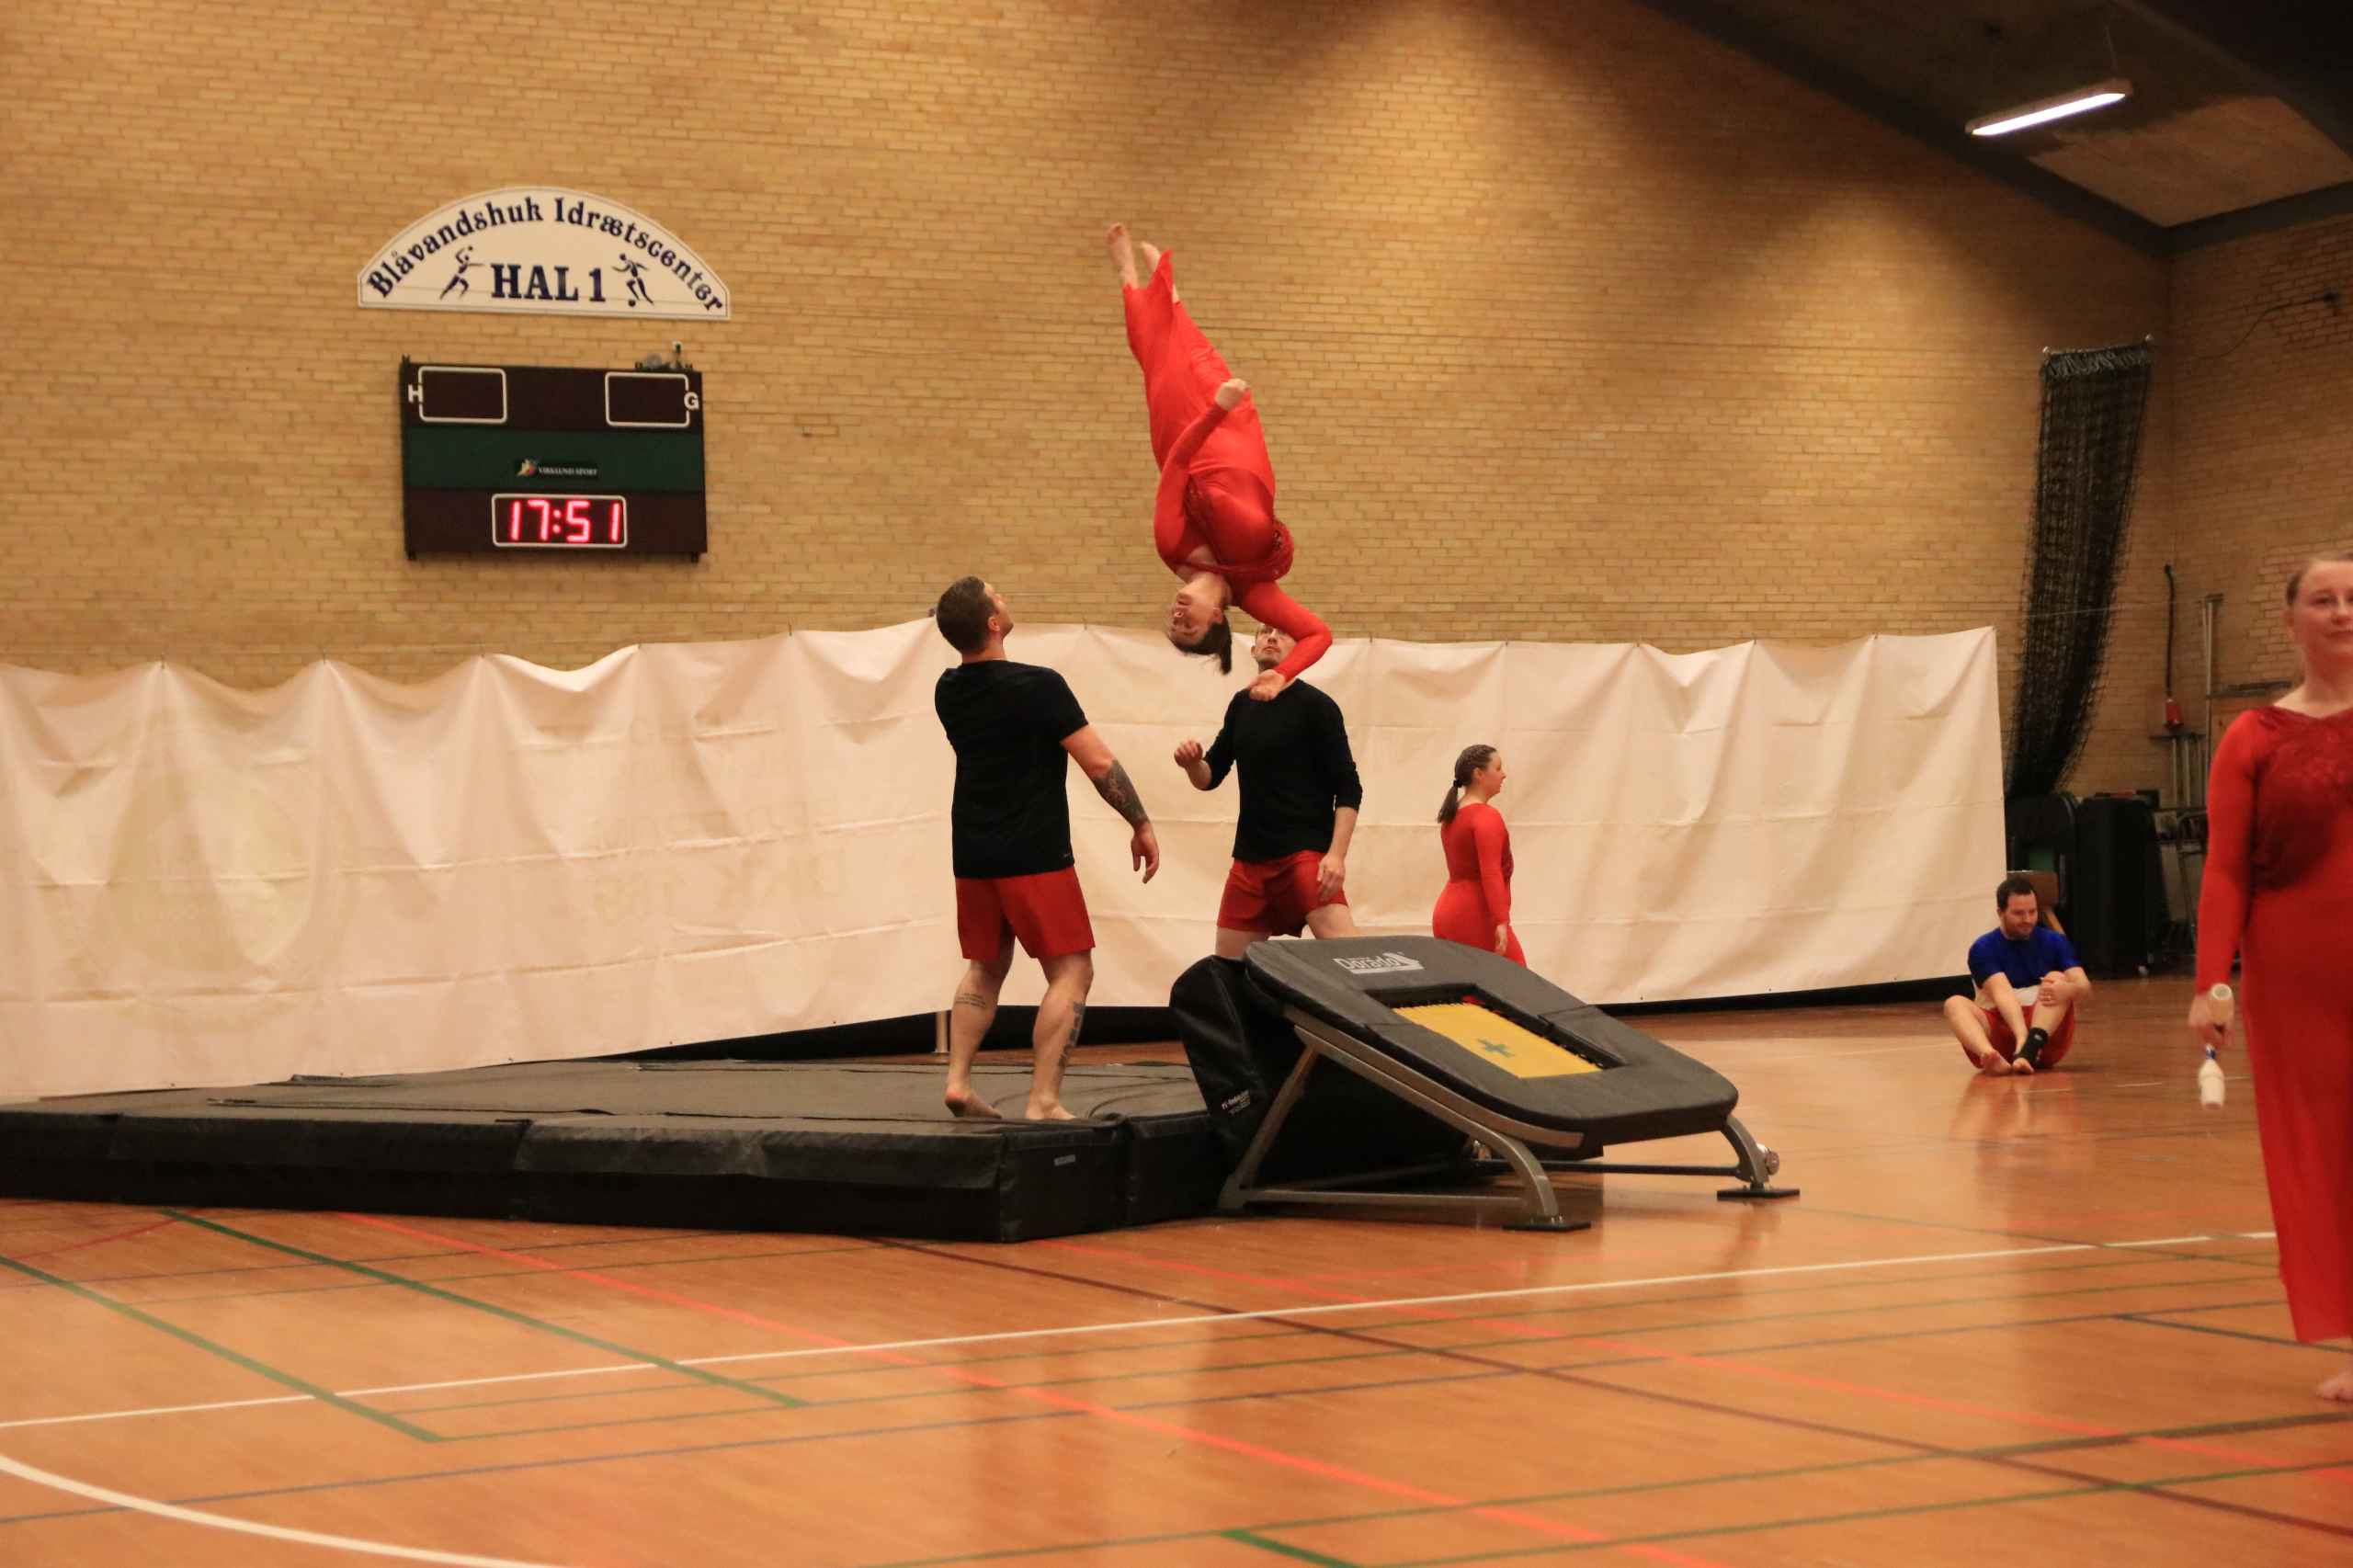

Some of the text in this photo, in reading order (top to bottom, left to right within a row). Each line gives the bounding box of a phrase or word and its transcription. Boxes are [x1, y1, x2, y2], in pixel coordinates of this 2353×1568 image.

[367, 196, 722, 312] Blåvandshuk Idrætscenter
[490, 264, 607, 302] HAL 1
[408, 384, 424, 403] H
[684, 392, 699, 410] G
[510, 499, 621, 543] 17:51
